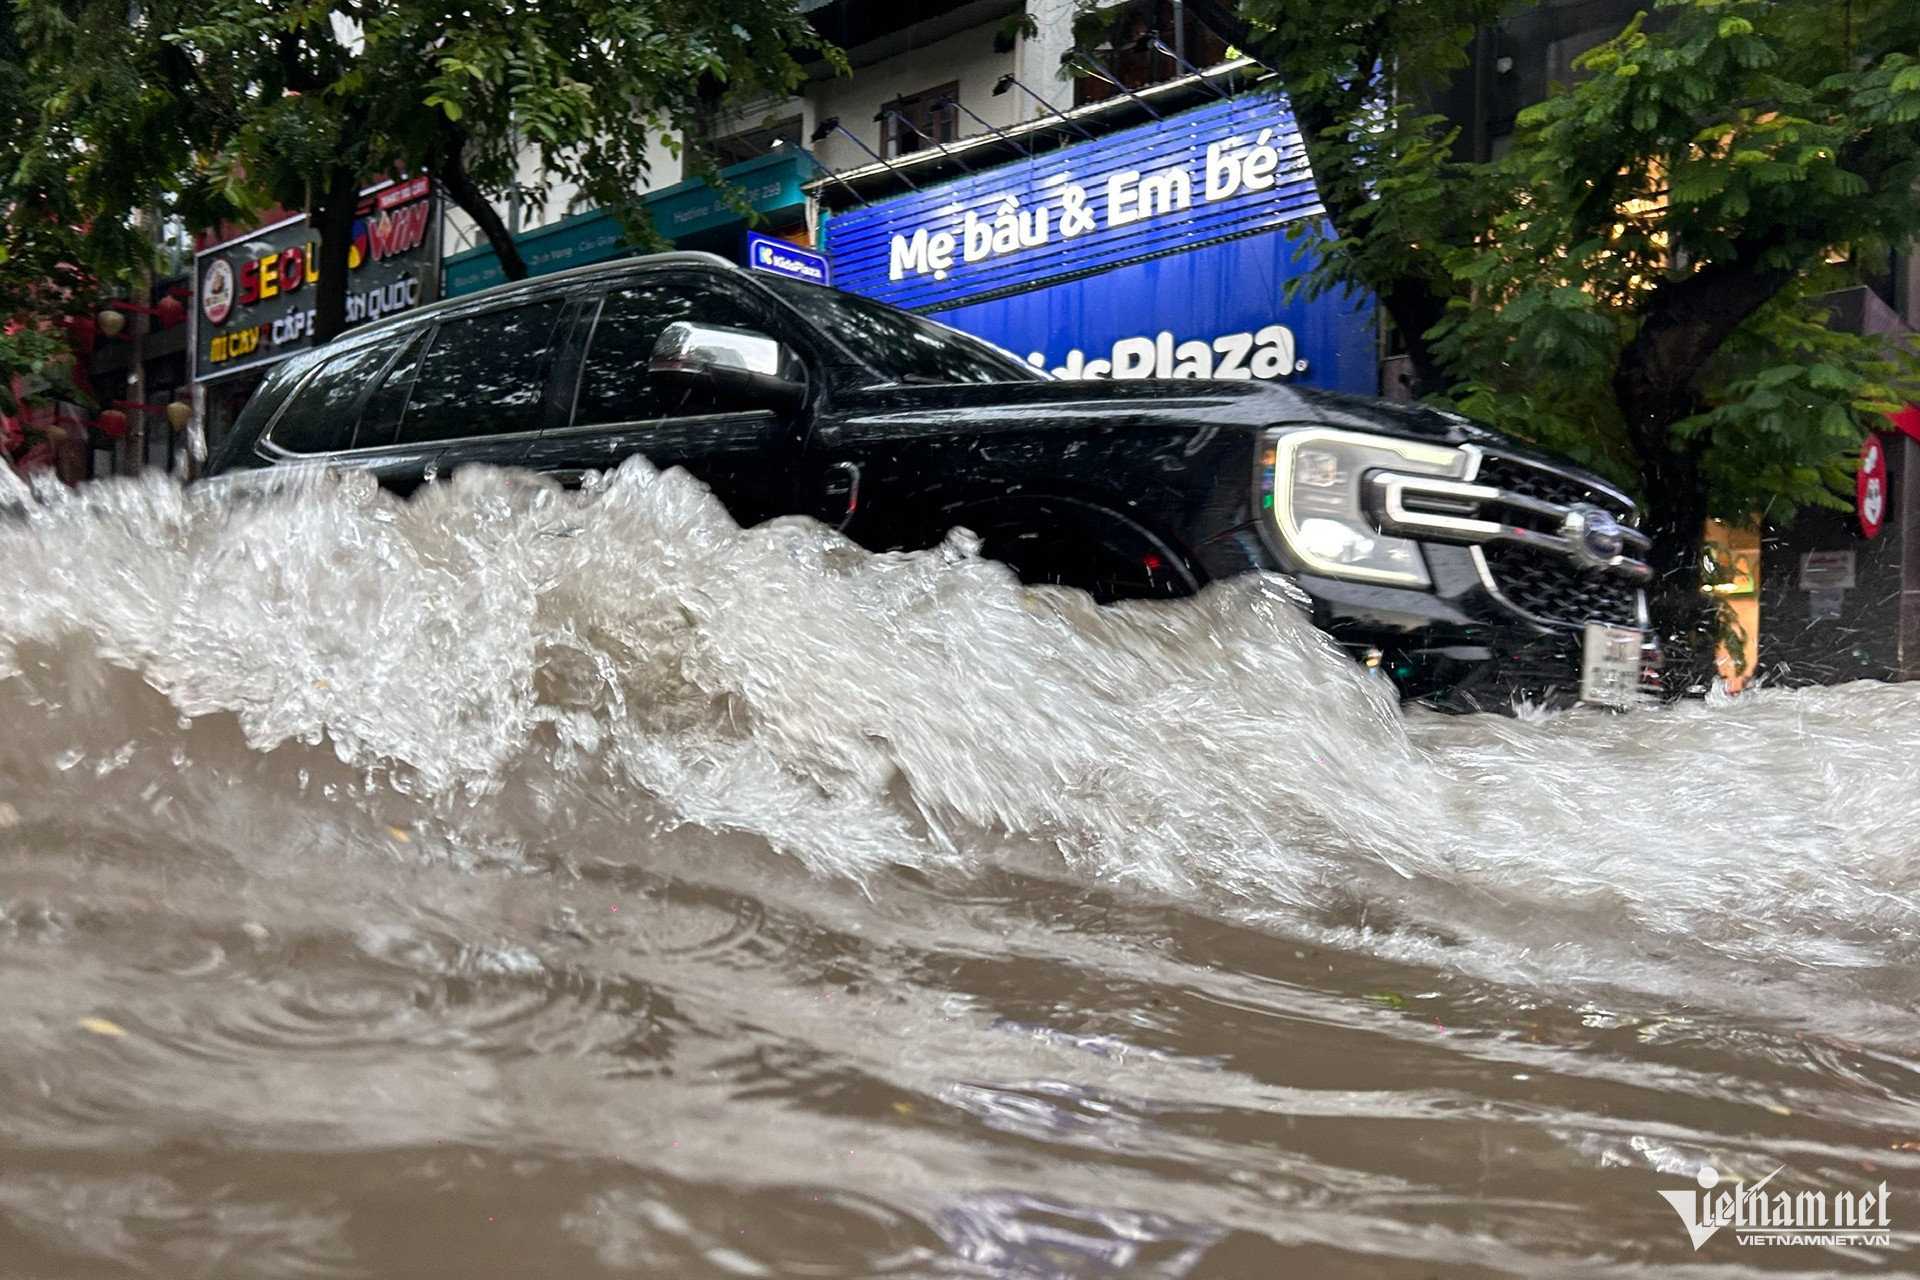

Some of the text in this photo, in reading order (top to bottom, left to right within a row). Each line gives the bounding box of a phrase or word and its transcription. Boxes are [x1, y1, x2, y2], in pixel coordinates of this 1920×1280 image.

[888, 128, 1279, 281] Mẹ bầu & Em bé
